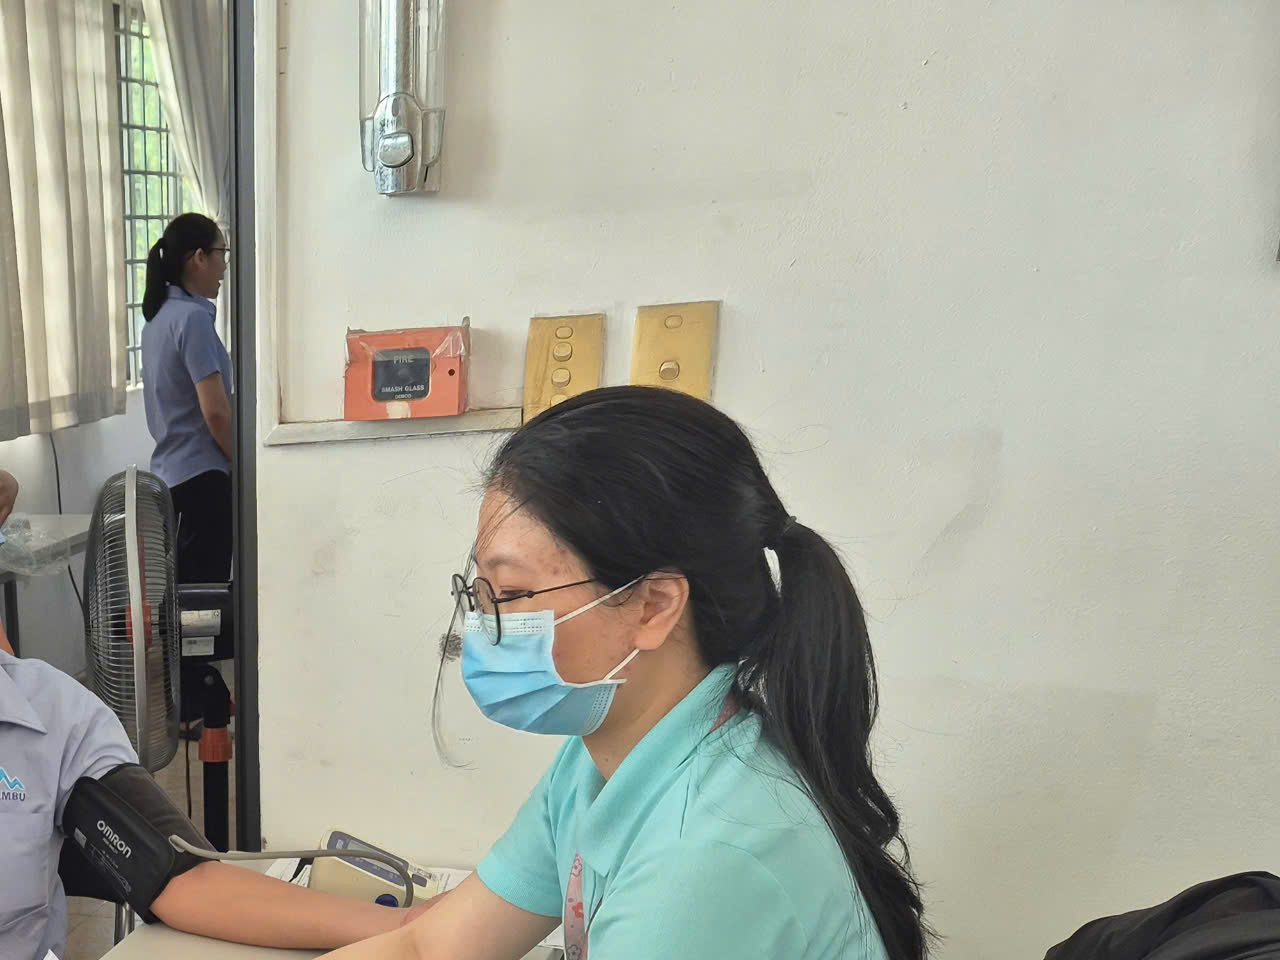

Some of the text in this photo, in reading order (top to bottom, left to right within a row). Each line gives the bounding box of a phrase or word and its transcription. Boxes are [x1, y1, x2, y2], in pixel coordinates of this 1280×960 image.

[393, 354, 415, 364] FIRE
[381, 384, 425, 393] SMASH GLASS
